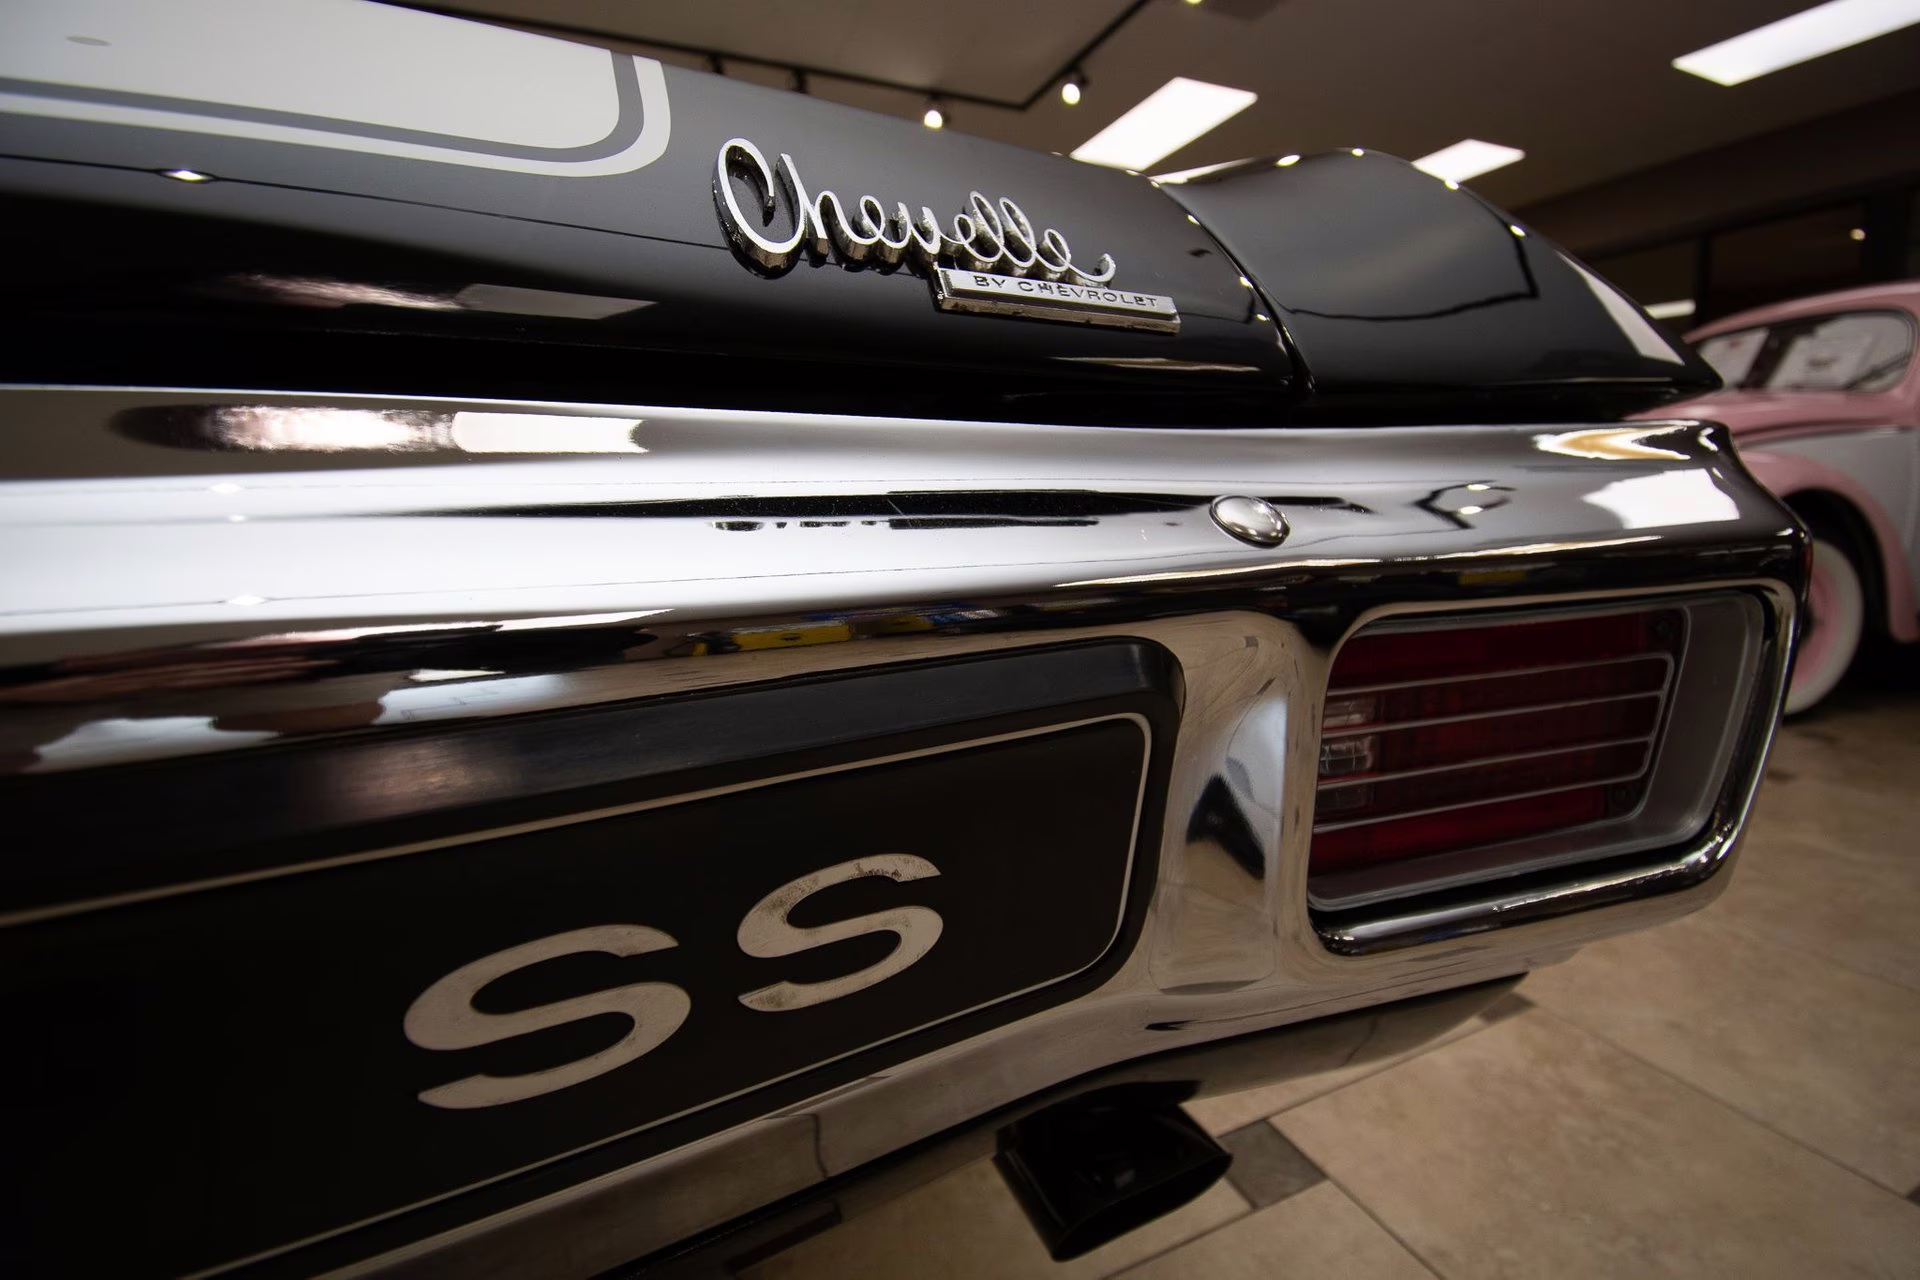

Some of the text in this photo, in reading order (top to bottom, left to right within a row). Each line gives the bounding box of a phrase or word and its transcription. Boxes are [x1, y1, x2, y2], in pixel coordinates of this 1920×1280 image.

[713, 137, 1117, 282] Chevelle
[974, 275, 1158, 308] BY CHEVROLET
[403, 853, 943, 1109] SS
